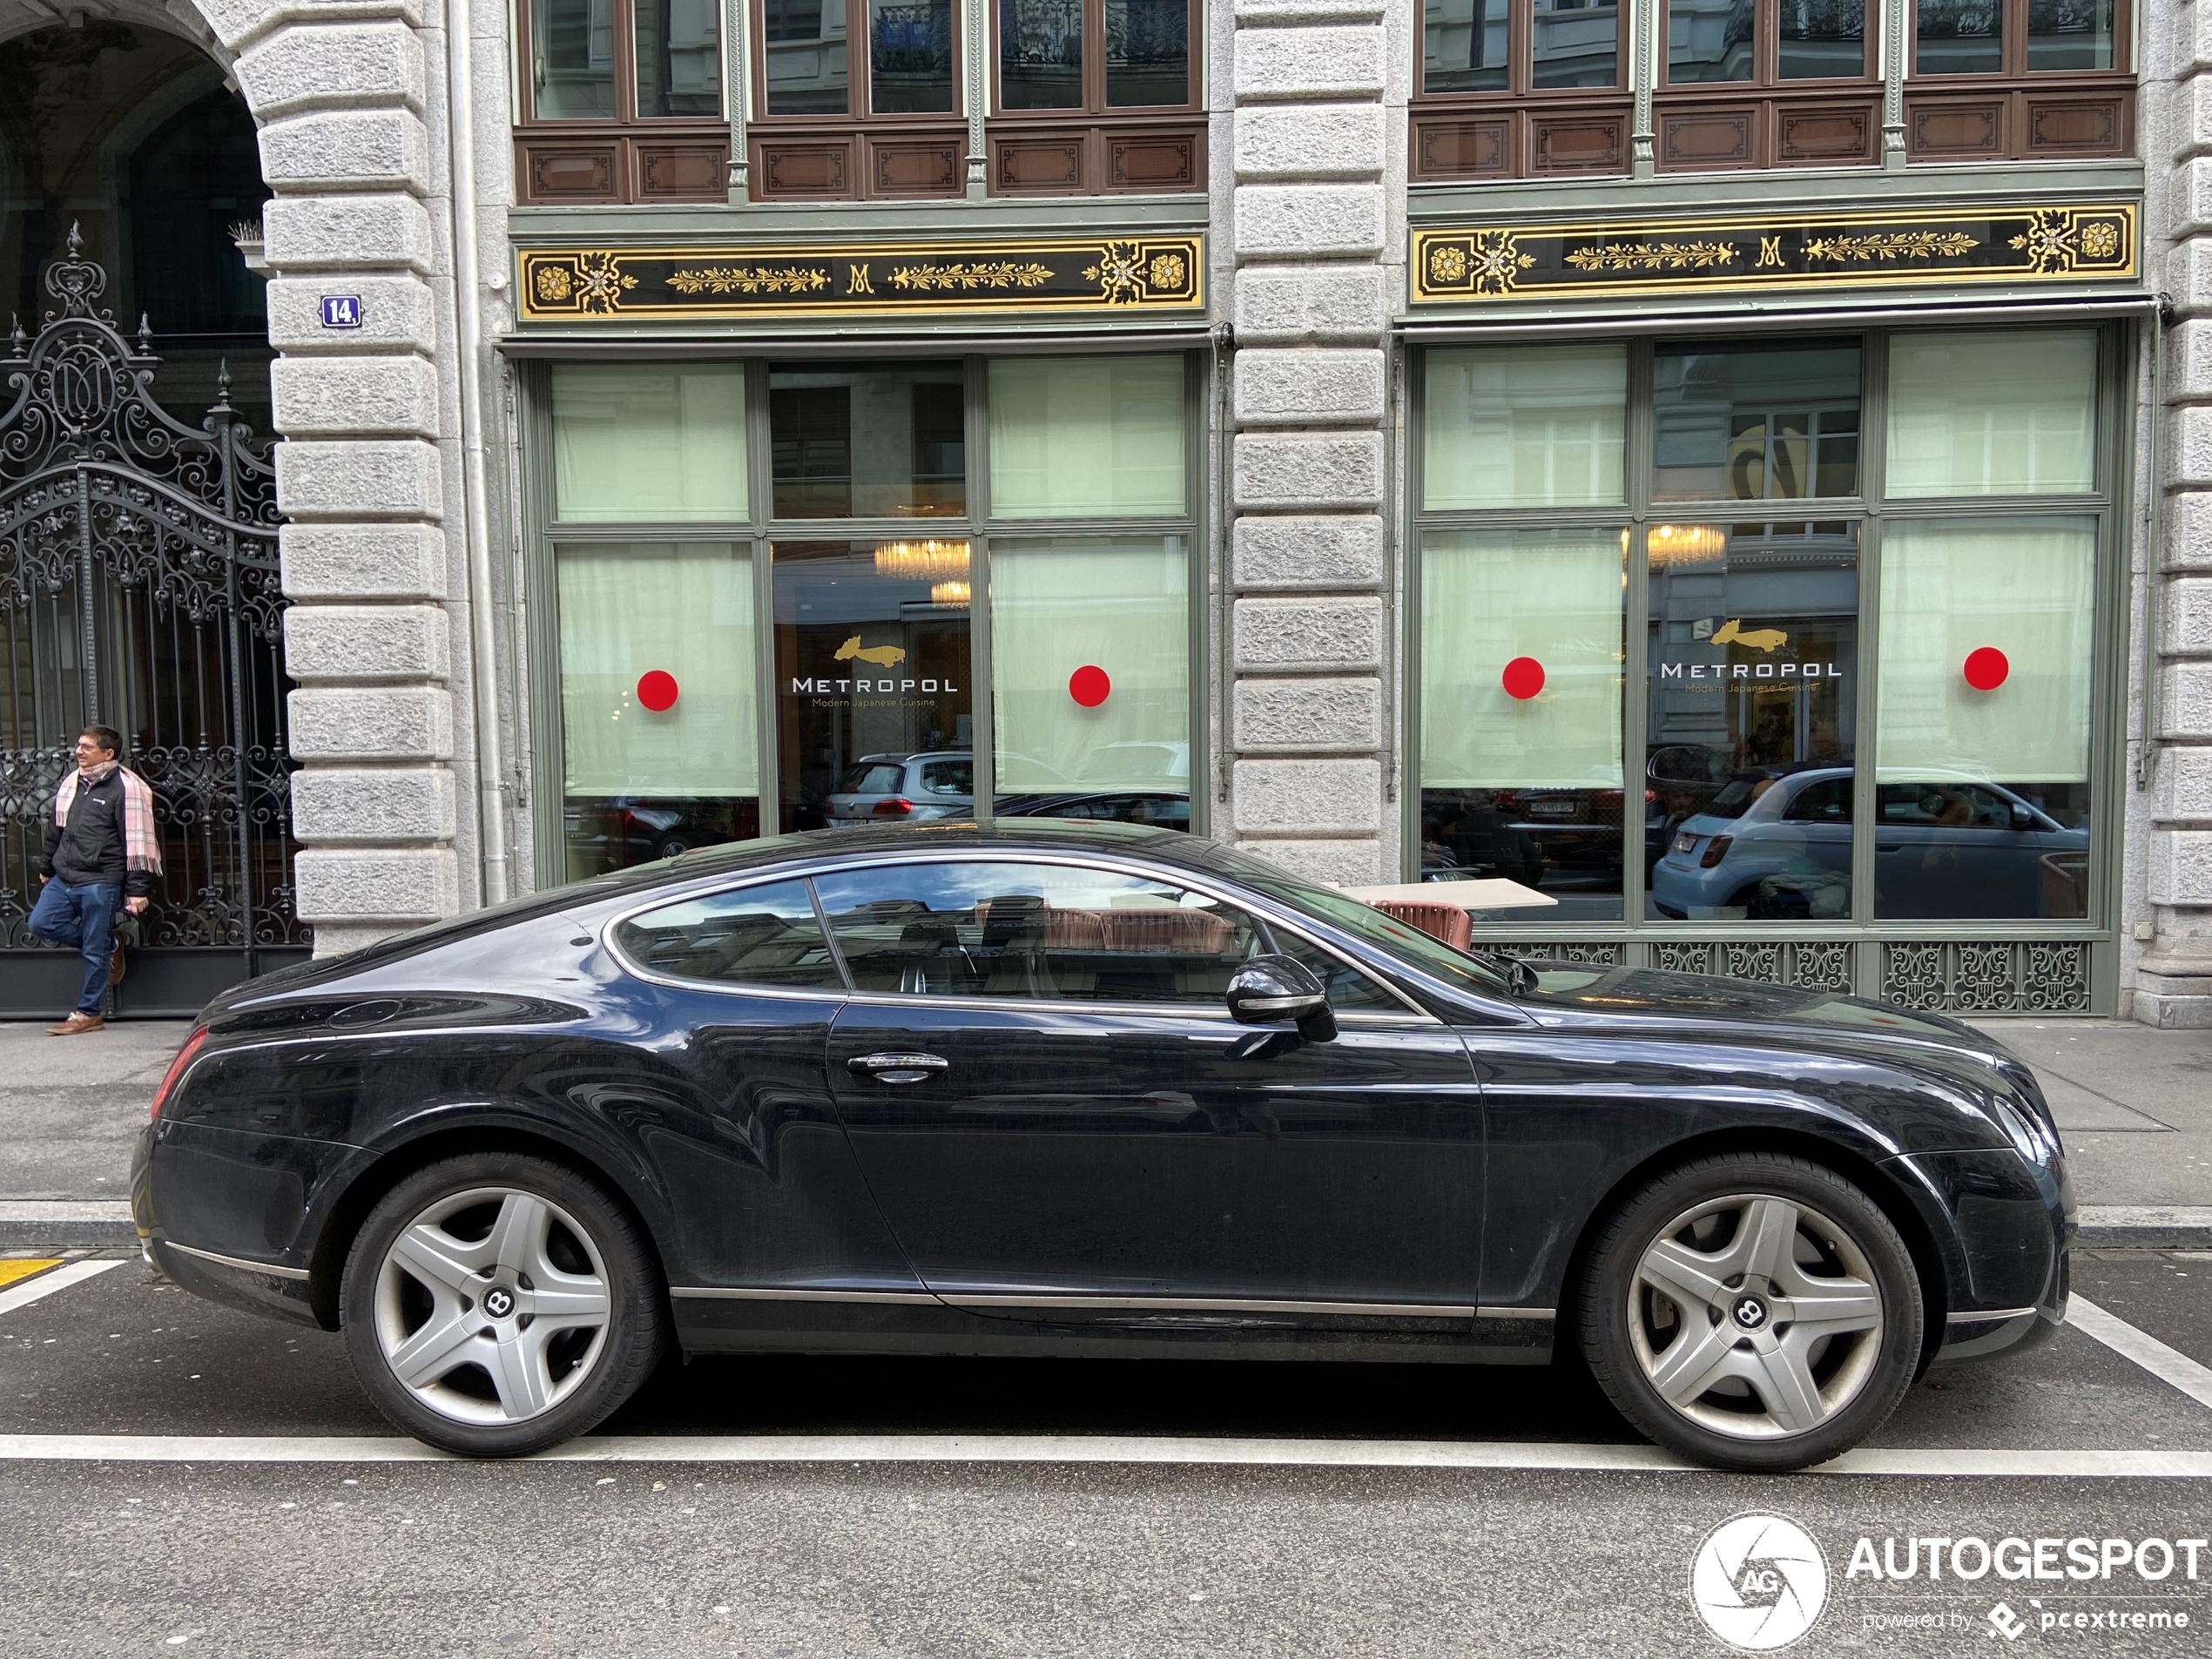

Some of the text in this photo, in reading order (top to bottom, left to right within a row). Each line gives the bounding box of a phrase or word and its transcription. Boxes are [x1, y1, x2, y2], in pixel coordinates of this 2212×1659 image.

[329, 299, 352, 323] 14
[1661, 663, 1843, 678] METROPOL
[792, 677, 958, 693] METROPOL
[1685, 682, 1817, 694] Modern Japanese Cuisine
[812, 697, 935, 709] Modern Japanese Cuisine
[488, 1291, 511, 1315] B
[1737, 1299, 1763, 1325] B
